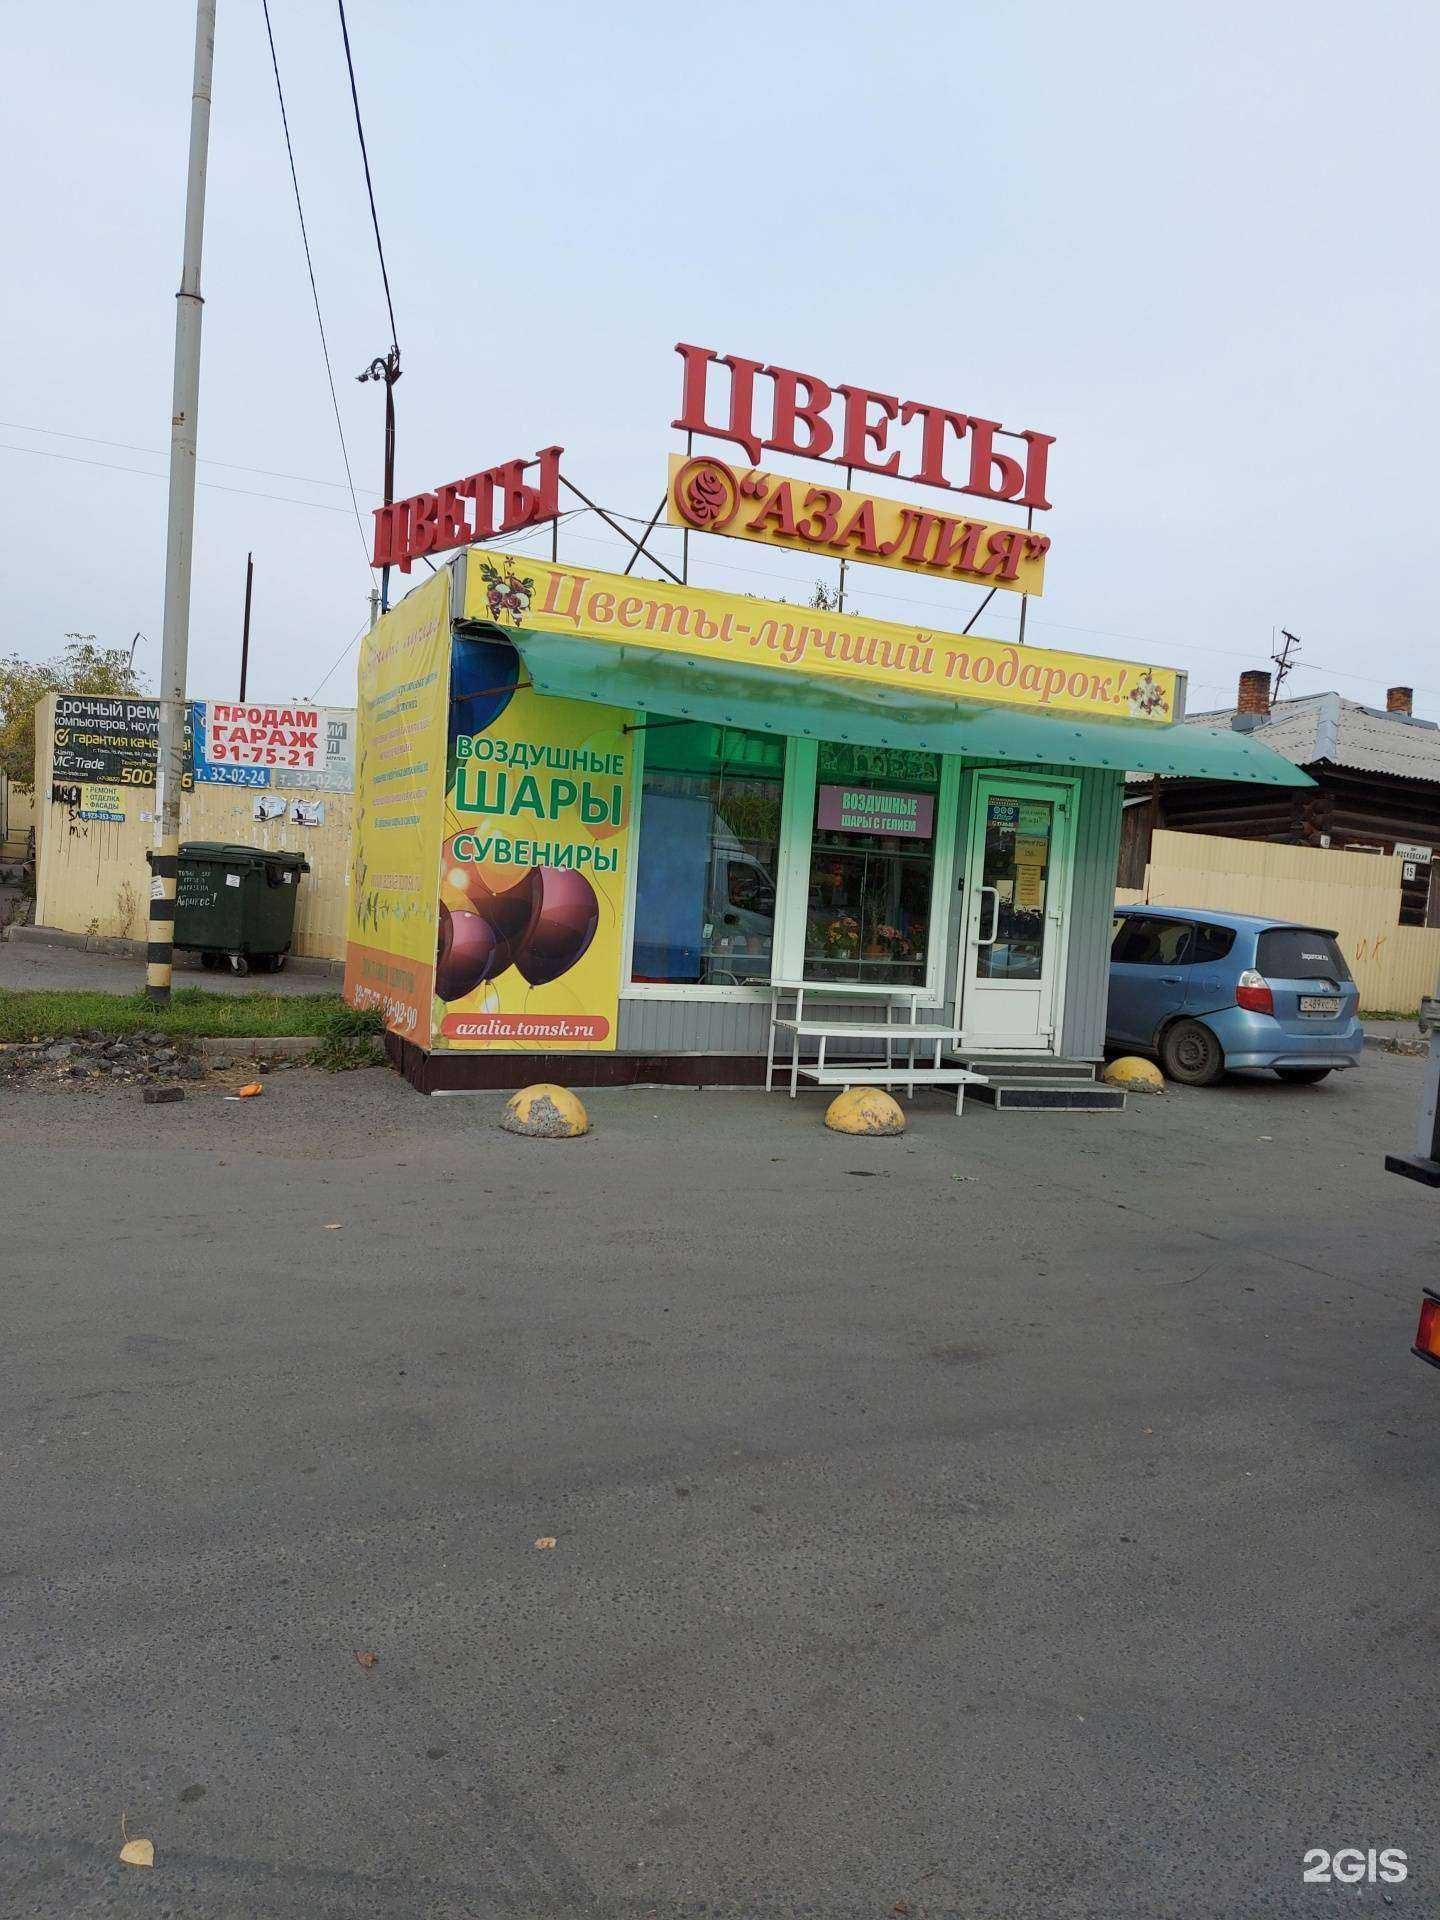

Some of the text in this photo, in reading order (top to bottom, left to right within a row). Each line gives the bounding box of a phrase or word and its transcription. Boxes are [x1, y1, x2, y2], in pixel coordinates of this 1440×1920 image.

[671, 342, 1056, 511] ЦВЕТЫ
[370, 445, 565, 573] ЦВЕТЫ
[536, 569, 935, 674] Цветы-лучший
[55, 697, 123, 718] Срочный
[214, 705, 317, 729] ПРОДАМ
[73, 732, 128, 746] гарантия
[212, 726, 319, 749] ГАРАЖ
[212, 744, 314, 767] 91-75-21
[456, 735, 625, 776] ВОЗДУШНЫЕ
[212, 767, 266, 784] 32-02-24
[455, 767, 623, 827] ШАРЫ
[842, 792, 918, 816] ВОЗДУШНЫЕ
[841, 814, 872, 828] ШАРЫ
[881, 818, 916, 832] ГЕЛИЕМ
[452, 834, 619, 873] СУВЕНИРЫ
[456, 1020, 595, 1037] azalia.tomsk.ru
